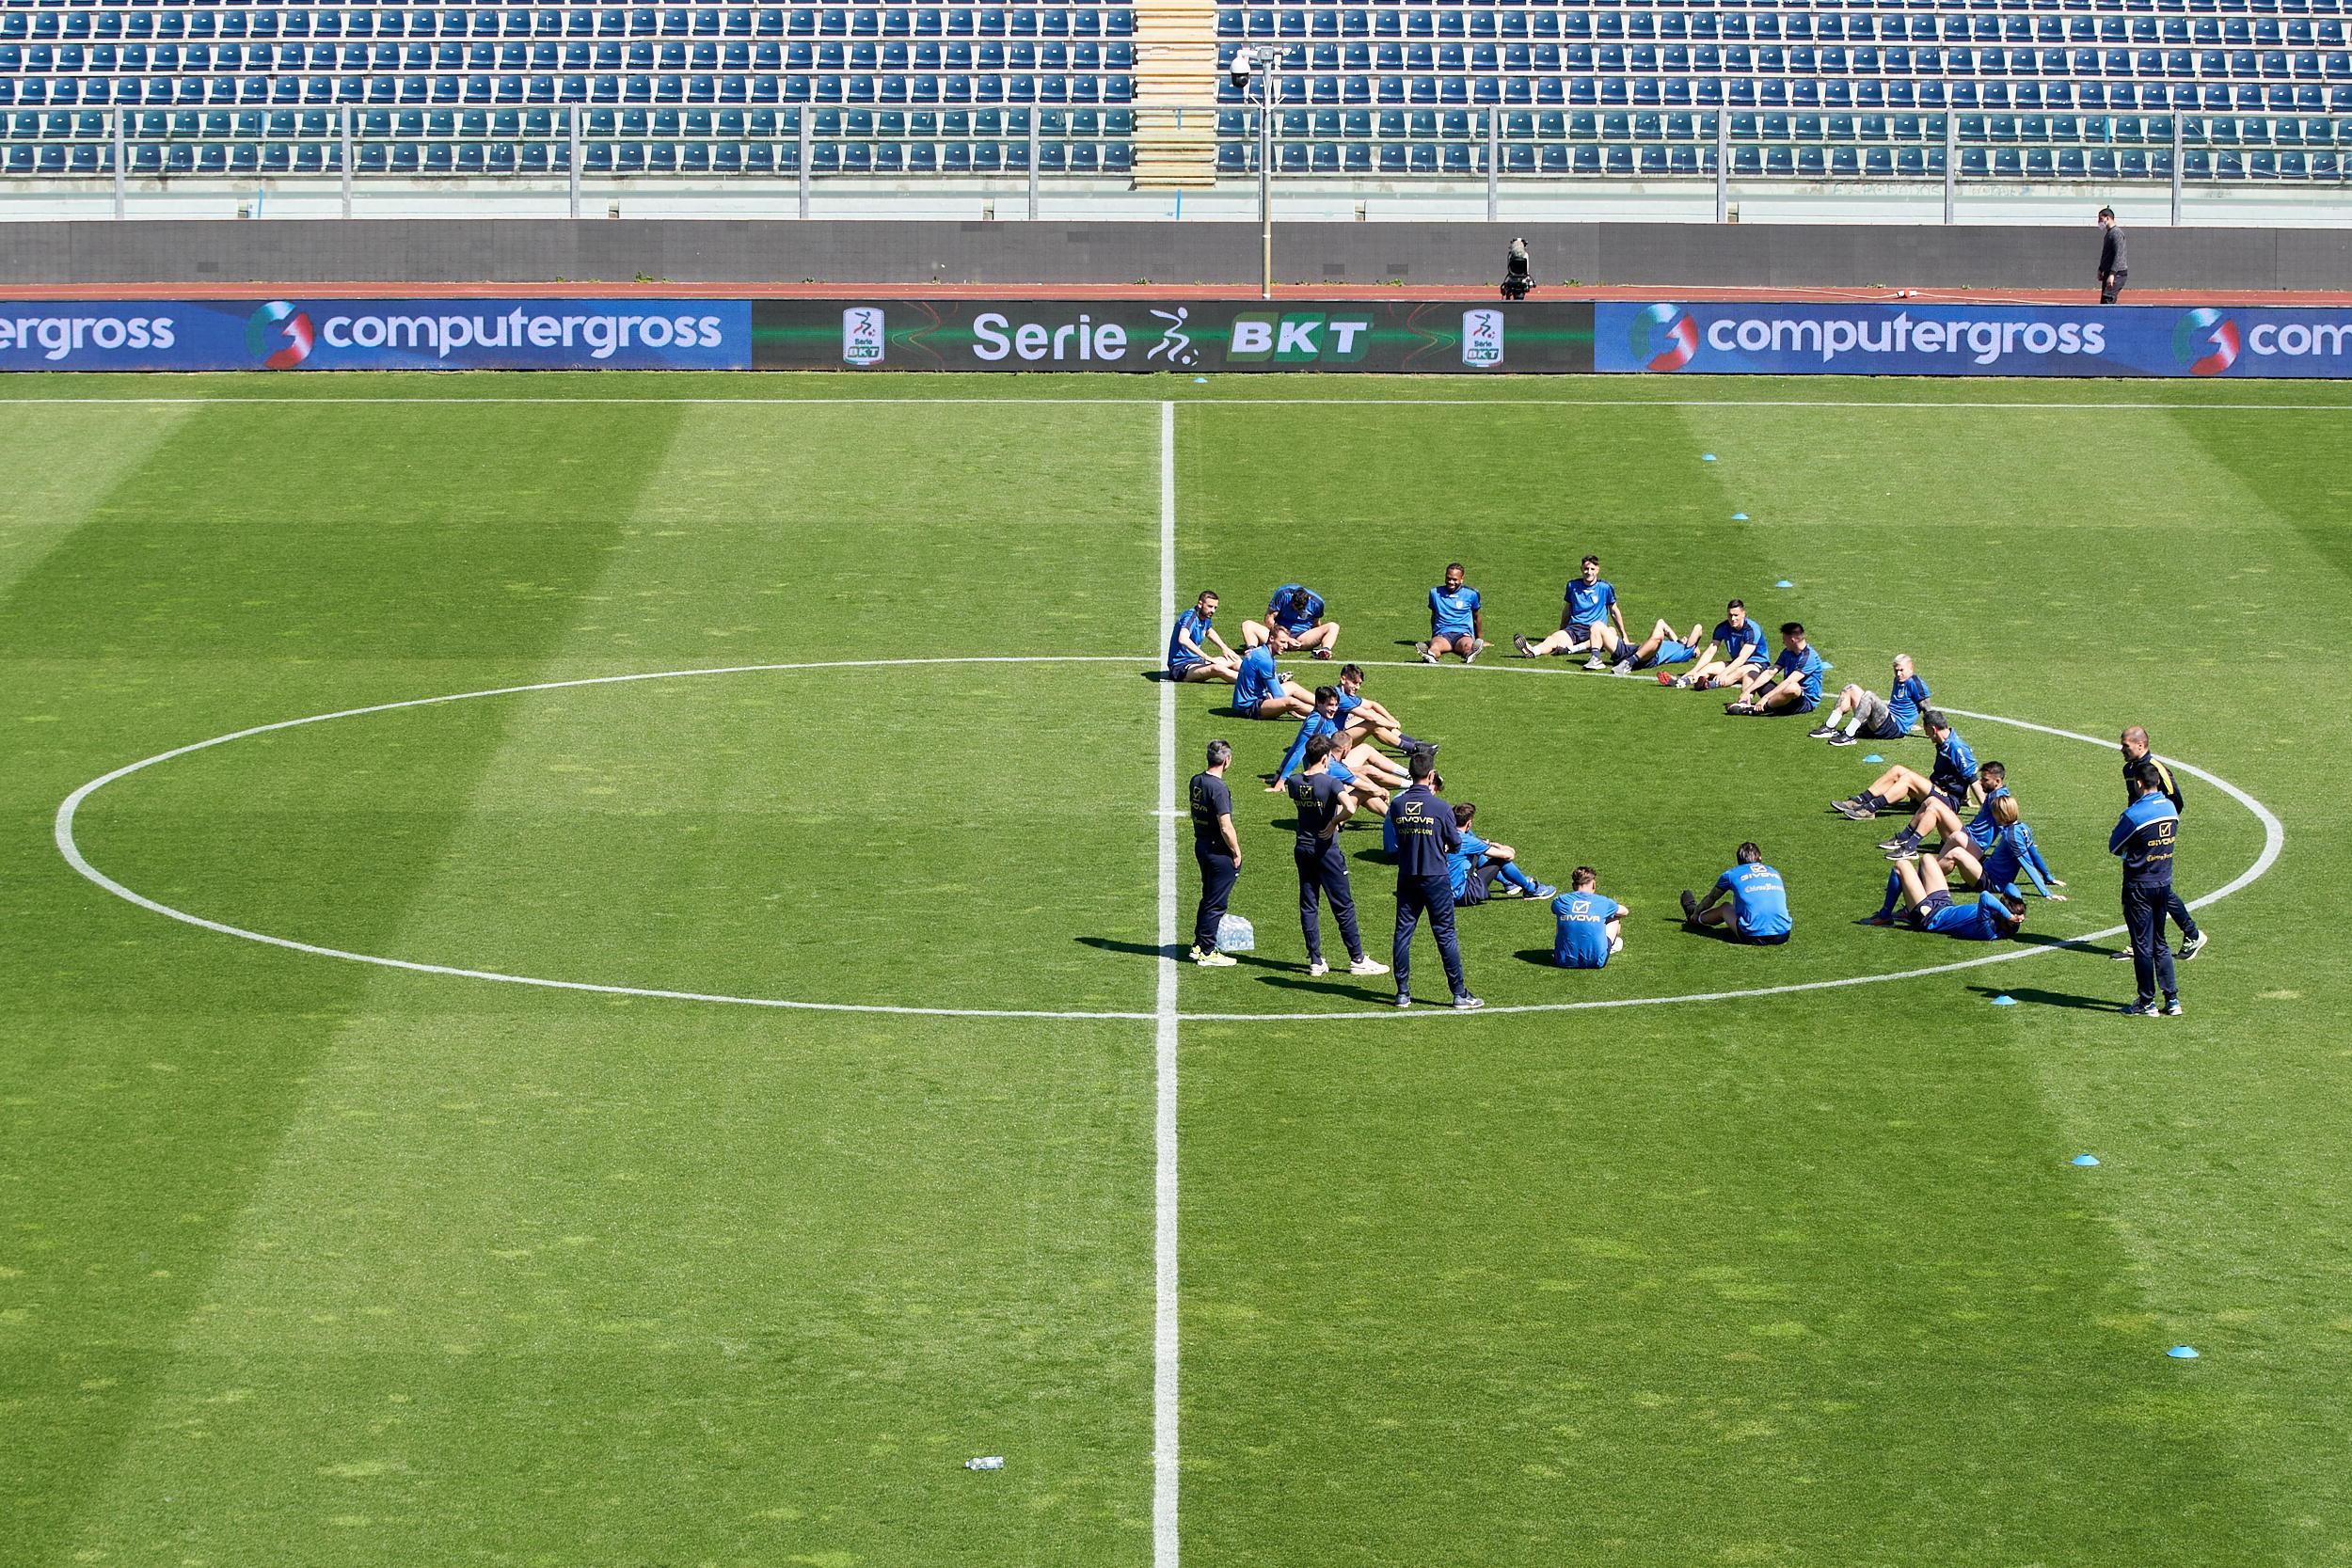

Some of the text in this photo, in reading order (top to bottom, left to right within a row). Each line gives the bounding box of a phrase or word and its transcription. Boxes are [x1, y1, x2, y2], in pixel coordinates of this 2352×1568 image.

[324, 307, 723, 359] computergross
[973, 313, 1368, 360] Serie BKT
[1708, 312, 2106, 365] computergross
[1396, 816, 1434, 825] GIVOVA
[2148, 837, 2176, 847] GIVOV
